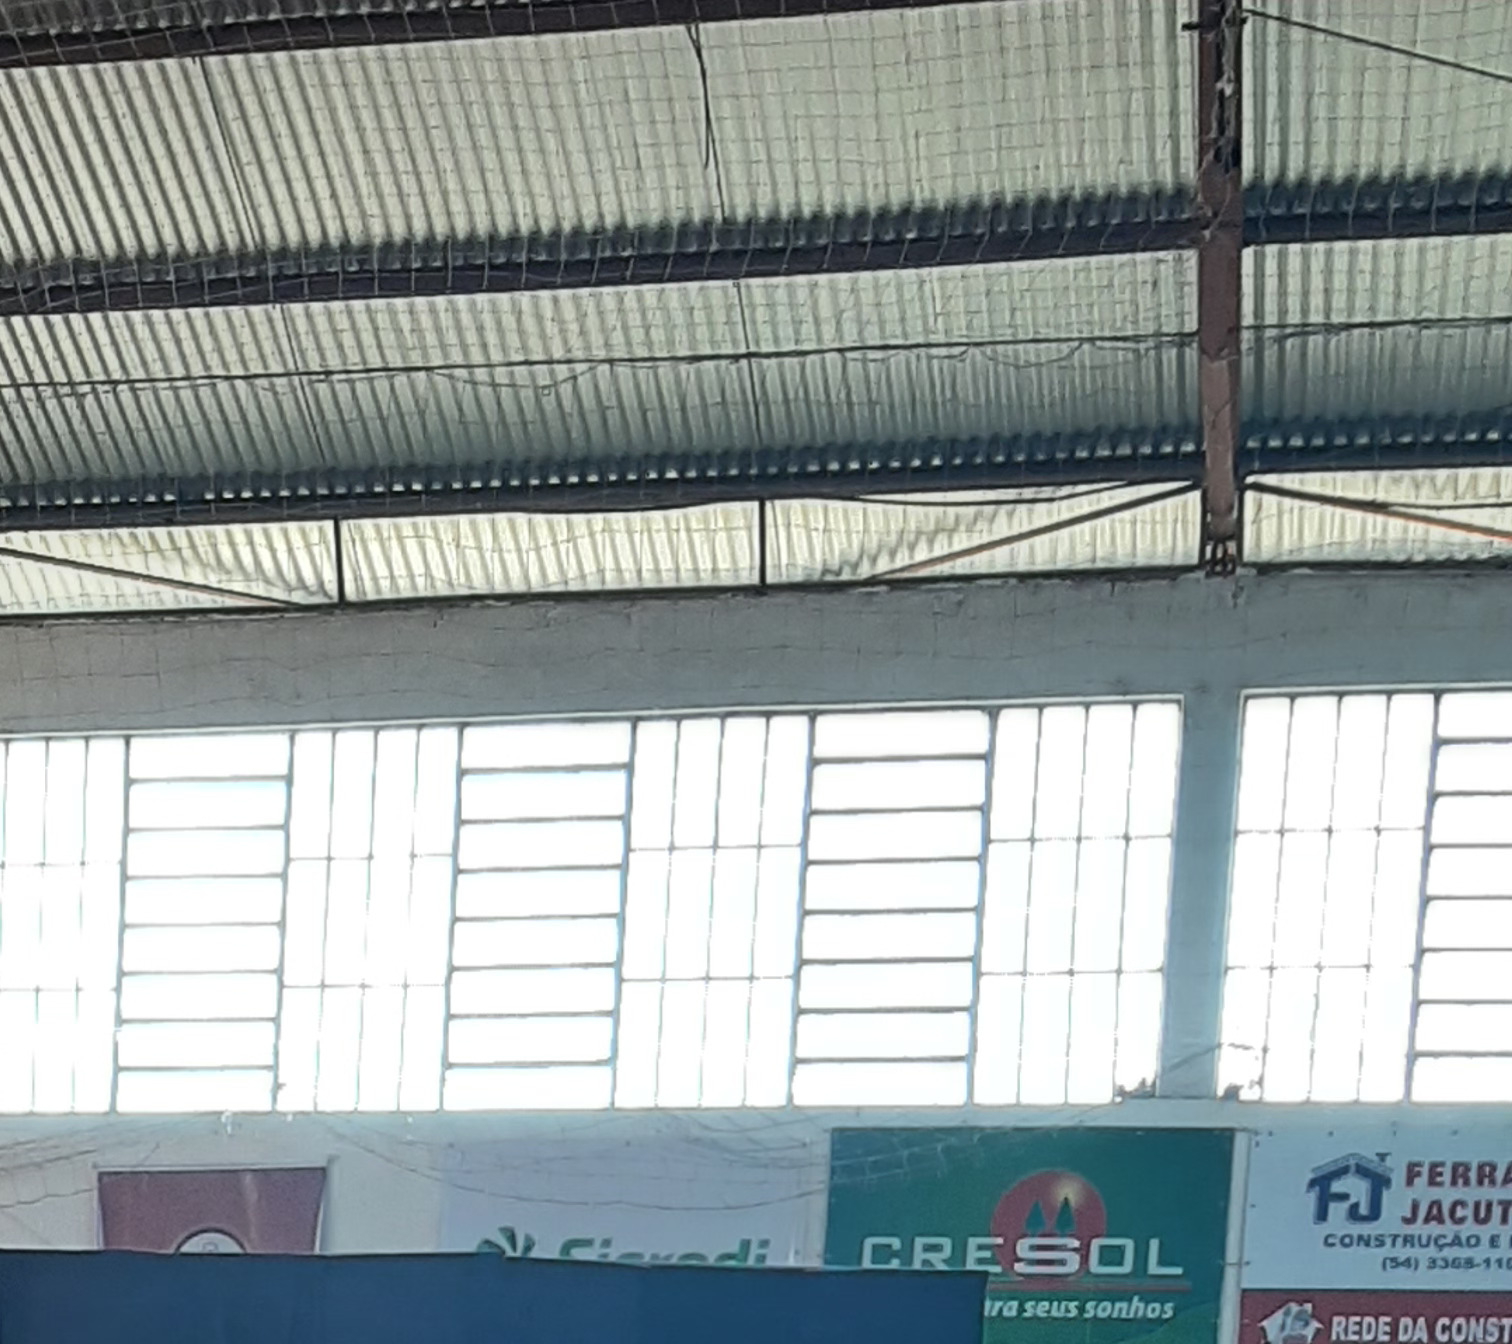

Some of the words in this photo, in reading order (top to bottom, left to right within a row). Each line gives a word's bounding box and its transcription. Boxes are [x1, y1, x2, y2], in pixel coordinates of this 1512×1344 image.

[1401, 1199, 1512, 1225] JACUT
[1323, 1230, 1481, 1253] CONSTRUÇÃO
[1489, 1234, 1501, 1248] E
[861, 1236, 1185, 1275] CRESOL
[1382, 1256, 1419, 1272] (54)
[1023, 1301, 1079, 1318] seus
[1083, 1297, 1174, 1319] sonhos
[1331, 1316, 1392, 1342] REDE
[1398, 1317, 1428, 1343] DA
[1435, 1317, 1512, 1344] CONST
